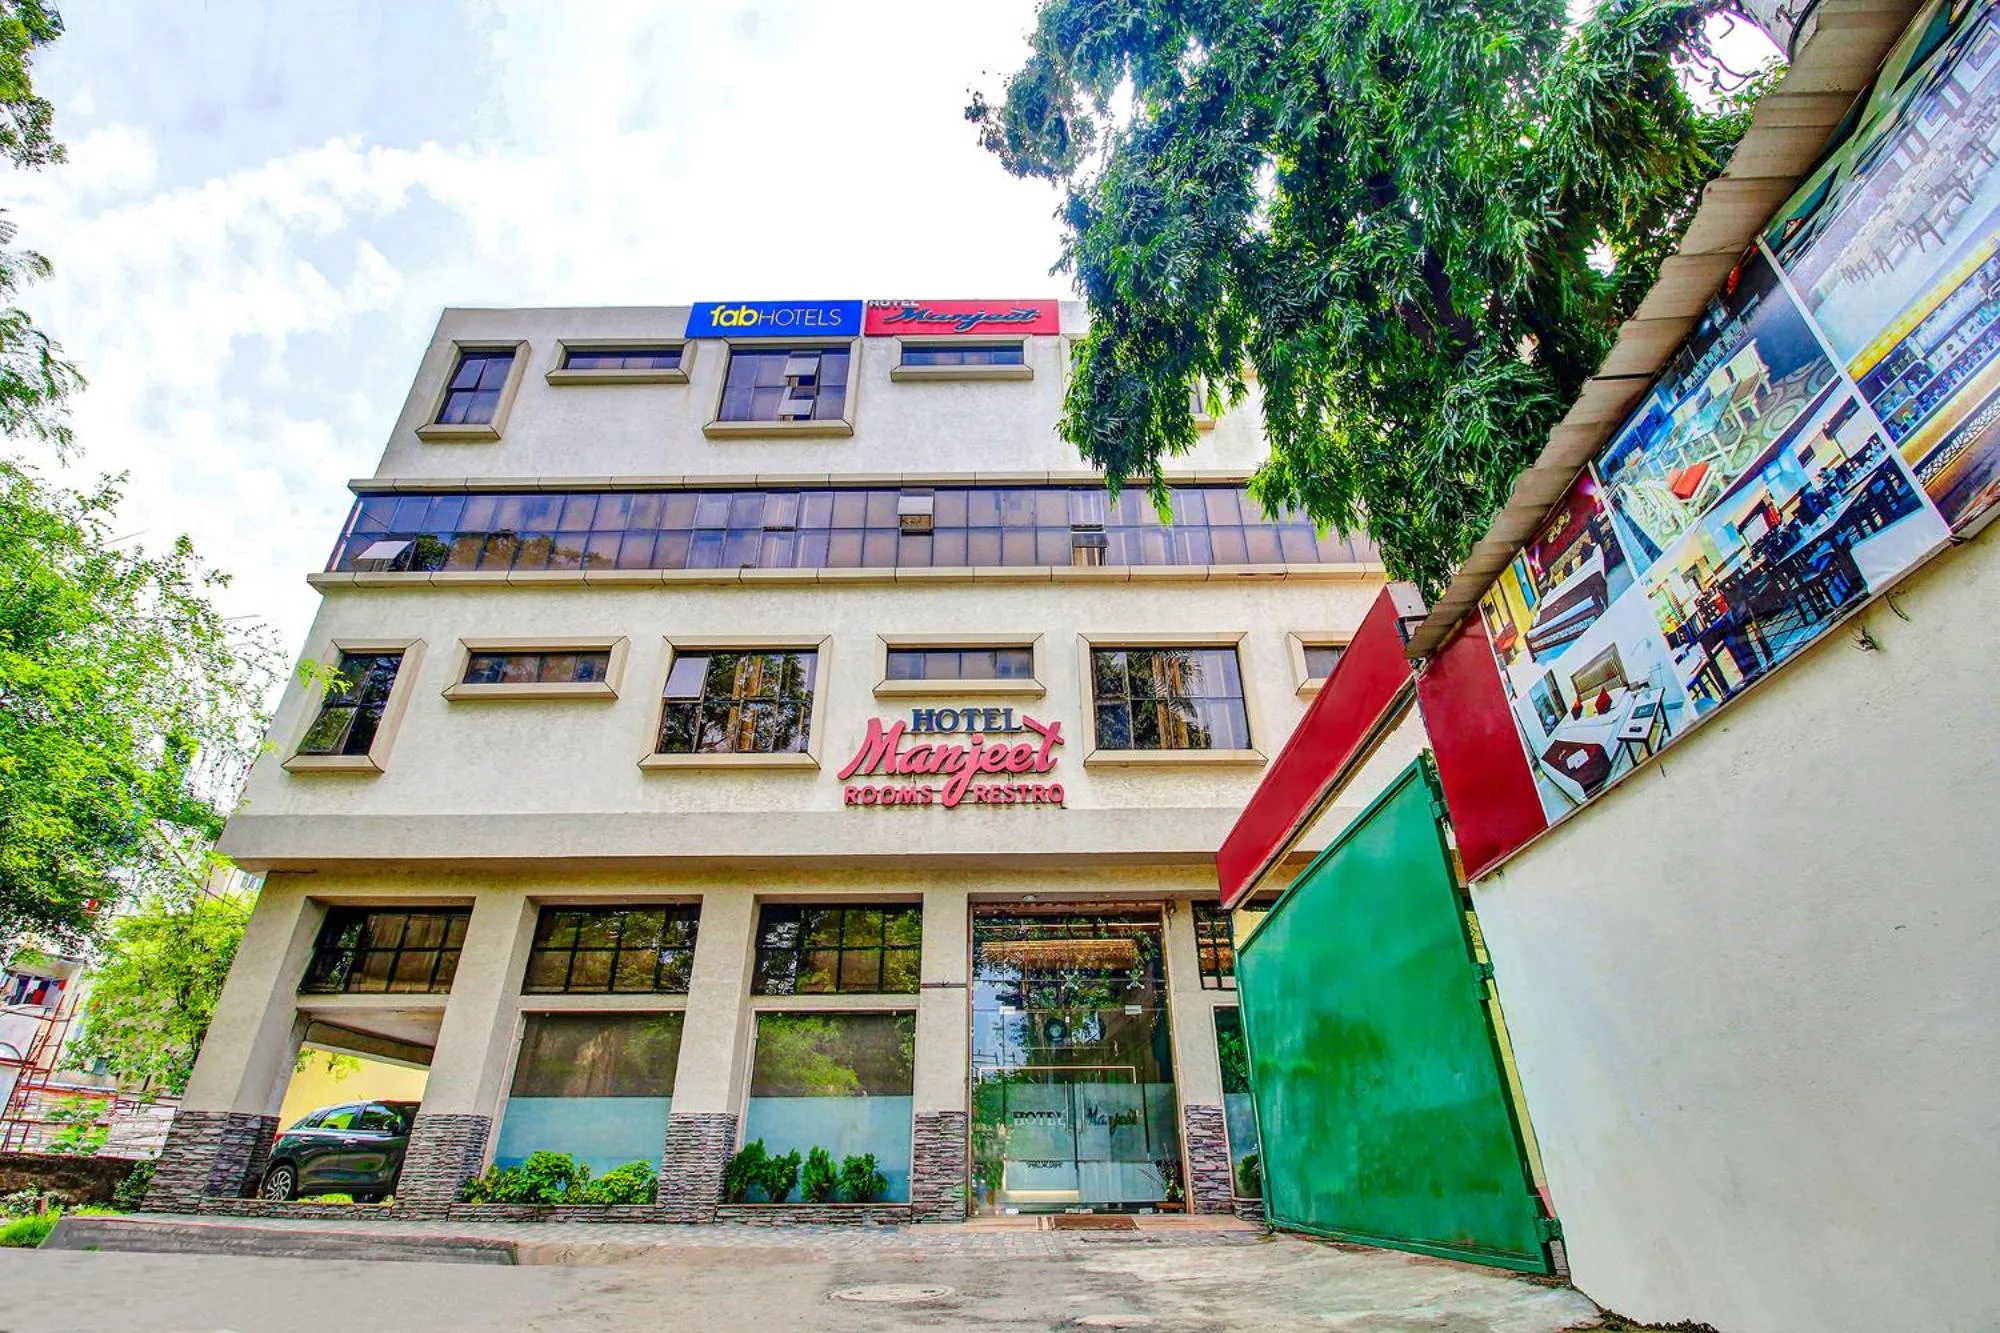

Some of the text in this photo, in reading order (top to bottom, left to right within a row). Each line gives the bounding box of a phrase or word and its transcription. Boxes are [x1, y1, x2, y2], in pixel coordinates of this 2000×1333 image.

[912, 708, 1023, 732] HOTEL
[838, 715, 1065, 808] Manjeet
[843, 783, 1066, 806] ROOMS RESTRO
[1013, 1111, 1066, 1126] HOTEL
